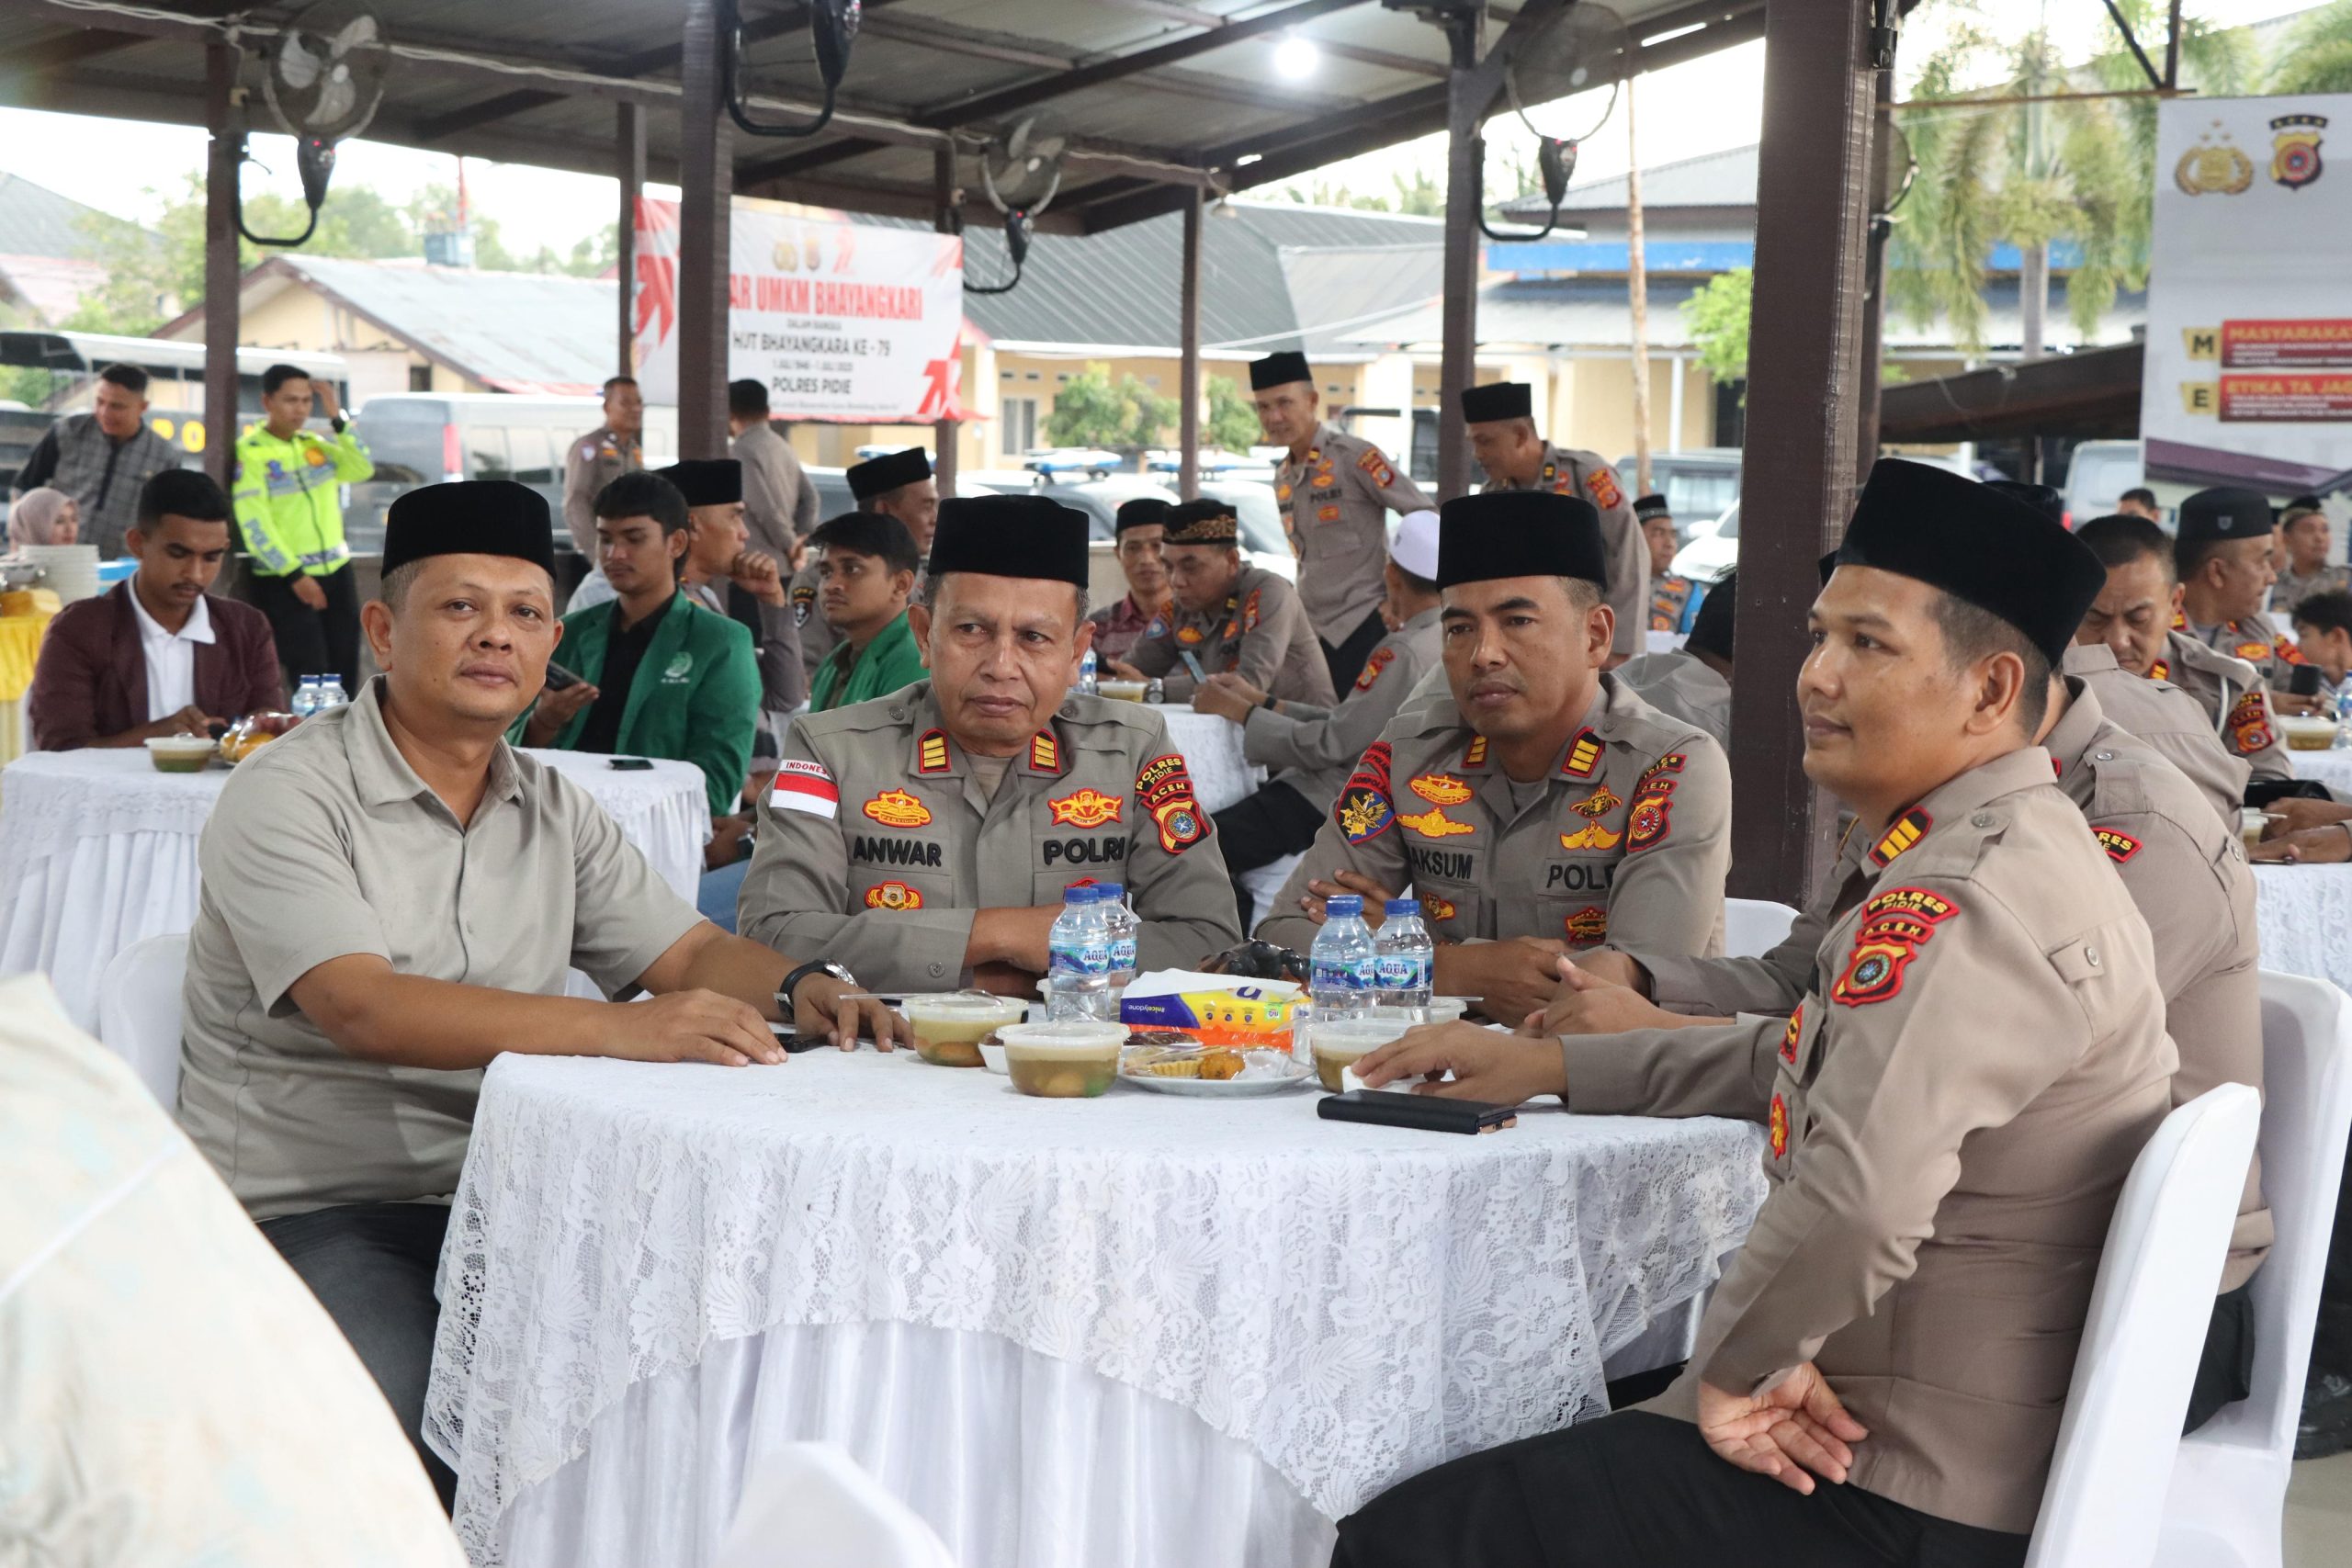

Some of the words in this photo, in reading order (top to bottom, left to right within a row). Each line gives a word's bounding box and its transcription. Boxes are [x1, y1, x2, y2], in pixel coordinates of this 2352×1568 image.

[757, 276, 810, 314] UMKM
[816, 281, 922, 320] BHAYANGKARI
[733, 331, 757, 350] HUT
[762, 333, 850, 355] BHAYANGKARA
[854, 338, 868, 356] KE
[2193, 334, 2214, 354] M
[772, 376, 818, 393] POLRES
[821, 378, 852, 394] PIDIE
[2227, 380, 2284, 394] ETIKA
[2289, 380, 2314, 394] TA
[2193, 389, 2210, 408] E
[1136, 758, 1182, 791] POLRES
[1149, 767, 1174, 785] PIDIE
[1150, 782, 1185, 804] ACEH
[853, 836, 942, 868] ANWAR
[1043, 837, 1125, 866] POLRI
[1868, 890, 1949, 914] POLRES
[1883, 899, 1923, 912] PIDIE
[1865, 921, 1921, 935] ACEH
[1083, 950, 1108, 962] AQUA
[1113, 945, 1135, 958] AQUA
[1379, 963, 1408, 976] AQUA
[1128, 1003, 1166, 1014] #nicelydone
